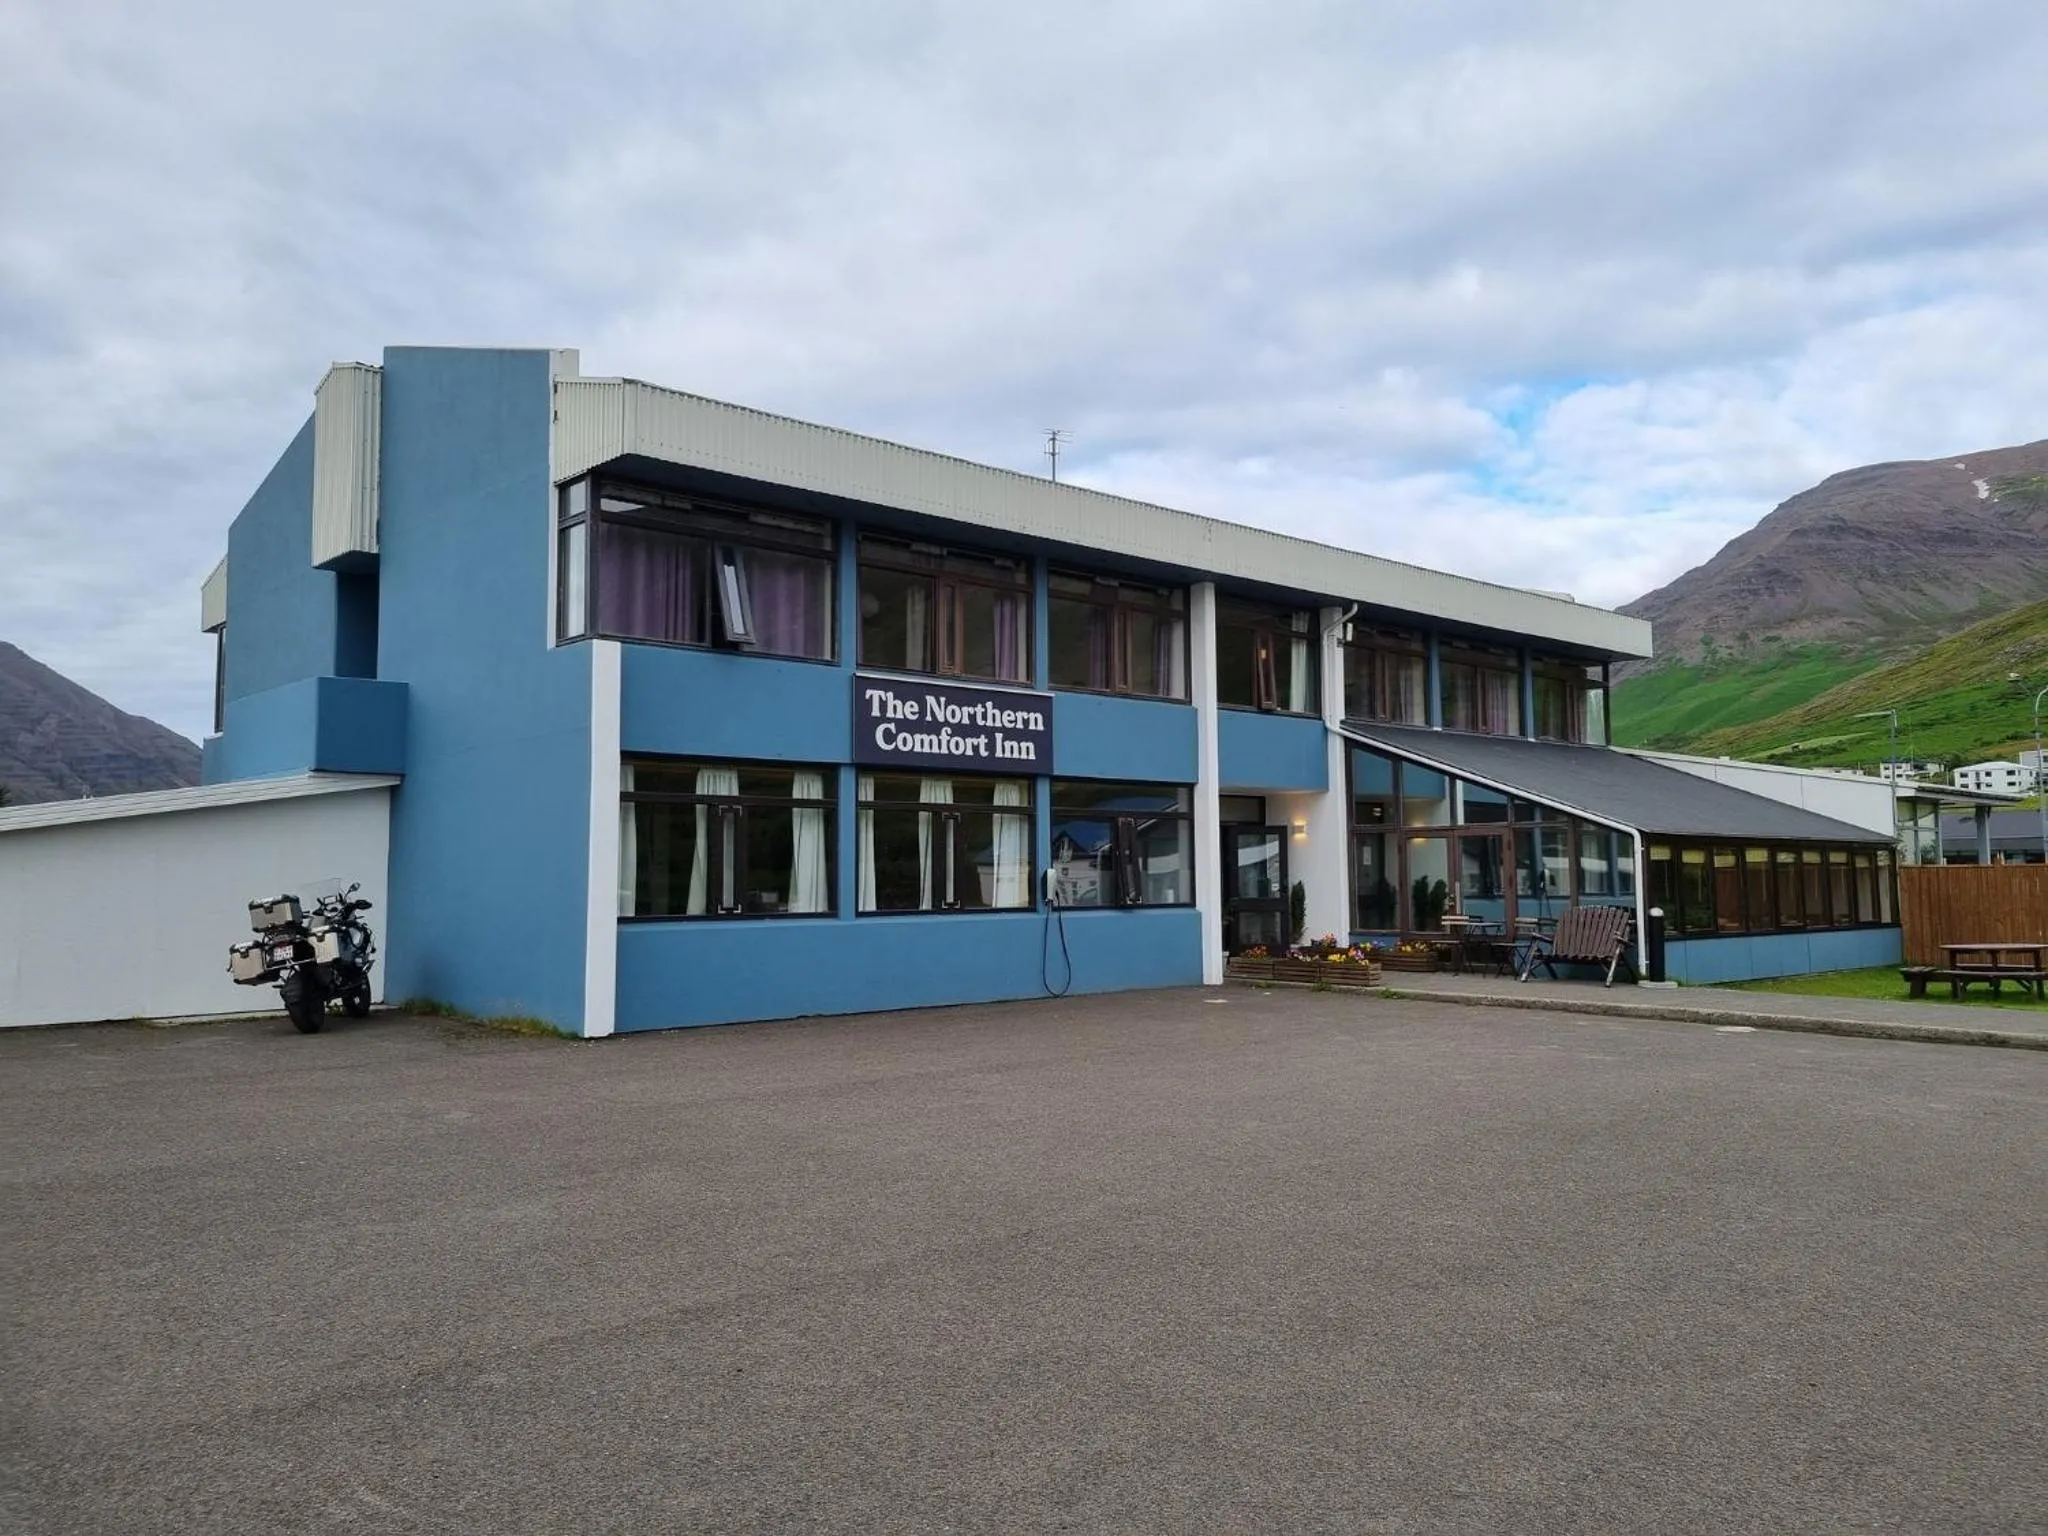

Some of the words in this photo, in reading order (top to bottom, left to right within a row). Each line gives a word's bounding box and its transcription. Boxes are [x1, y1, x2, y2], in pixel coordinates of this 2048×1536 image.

[865, 689, 919, 721] The
[925, 695, 1045, 731] Northern
[875, 723, 989, 757] Comfort
[994, 732, 1036, 760] Inn
